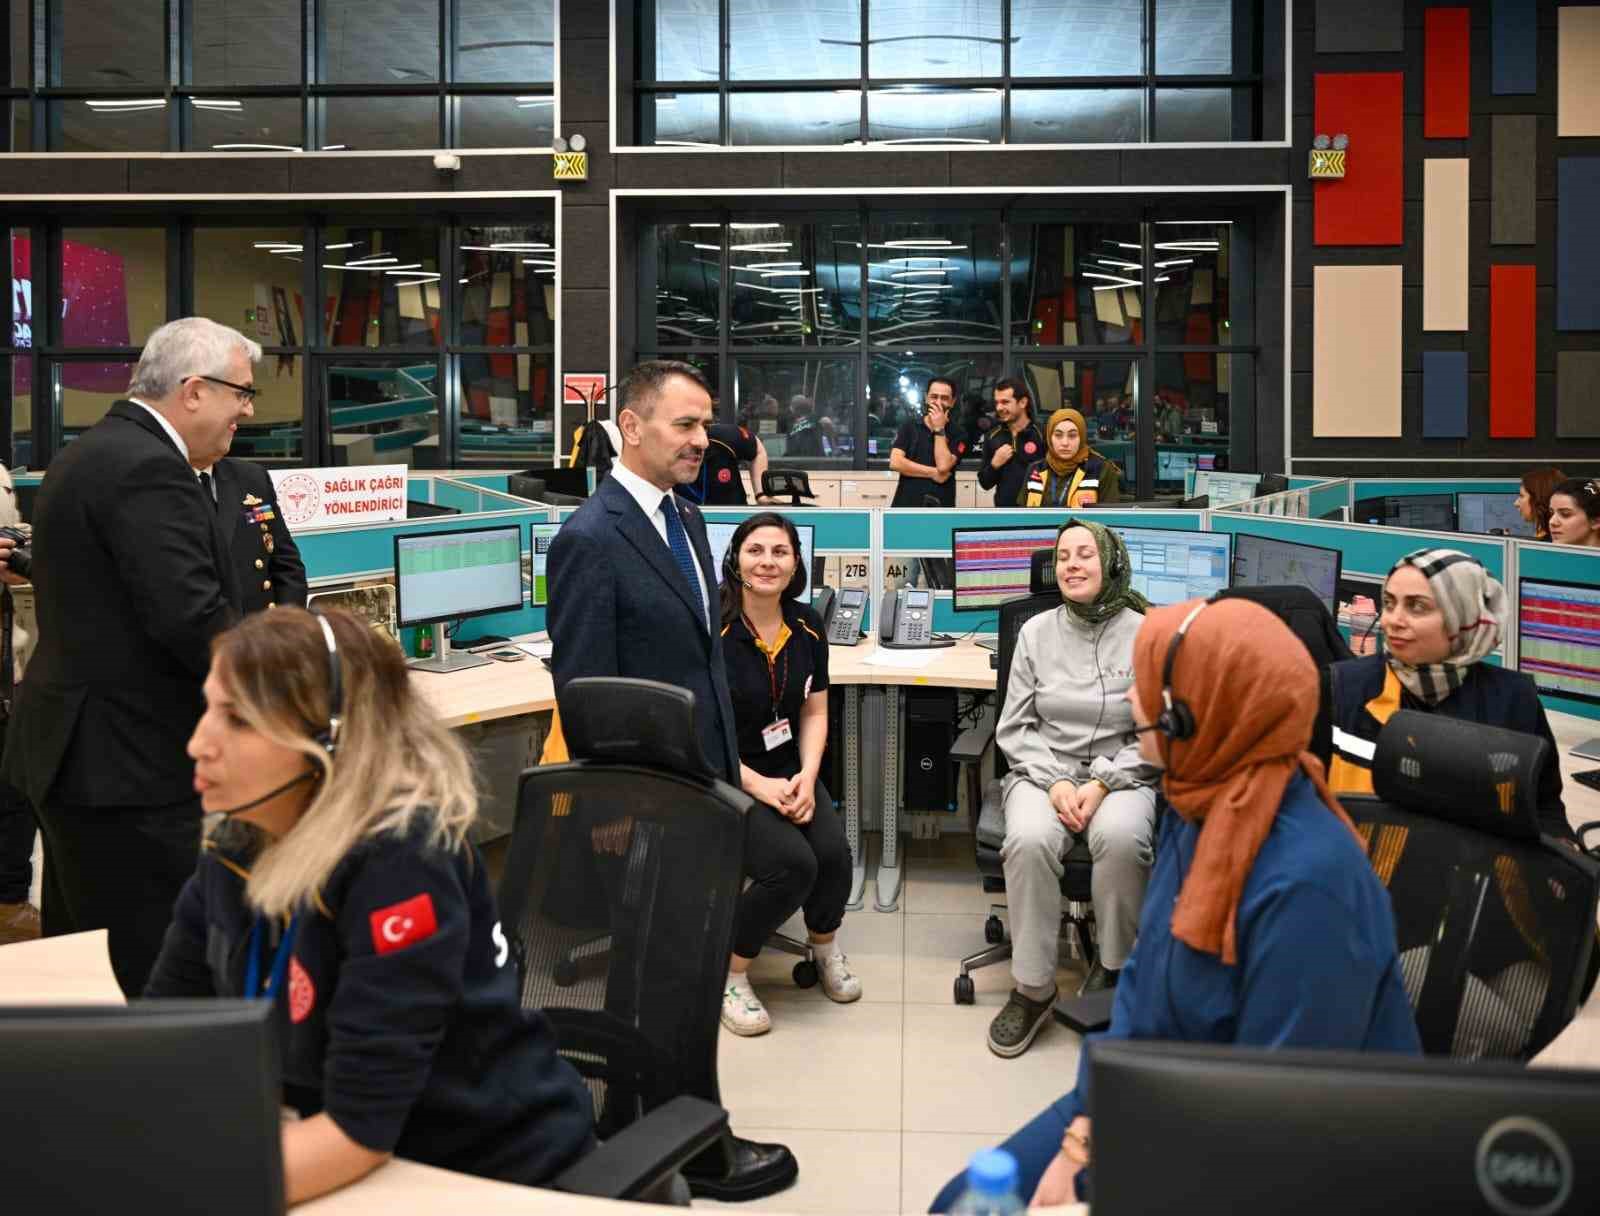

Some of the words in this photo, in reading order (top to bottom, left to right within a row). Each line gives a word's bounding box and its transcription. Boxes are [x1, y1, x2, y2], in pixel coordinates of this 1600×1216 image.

[324, 478, 366, 493] SAĞLIK
[369, 475, 403, 493] ÇAĞRI
[324, 496, 403, 515] YÖNLENDİRİCİ
[845, 564, 867, 577] 27B
